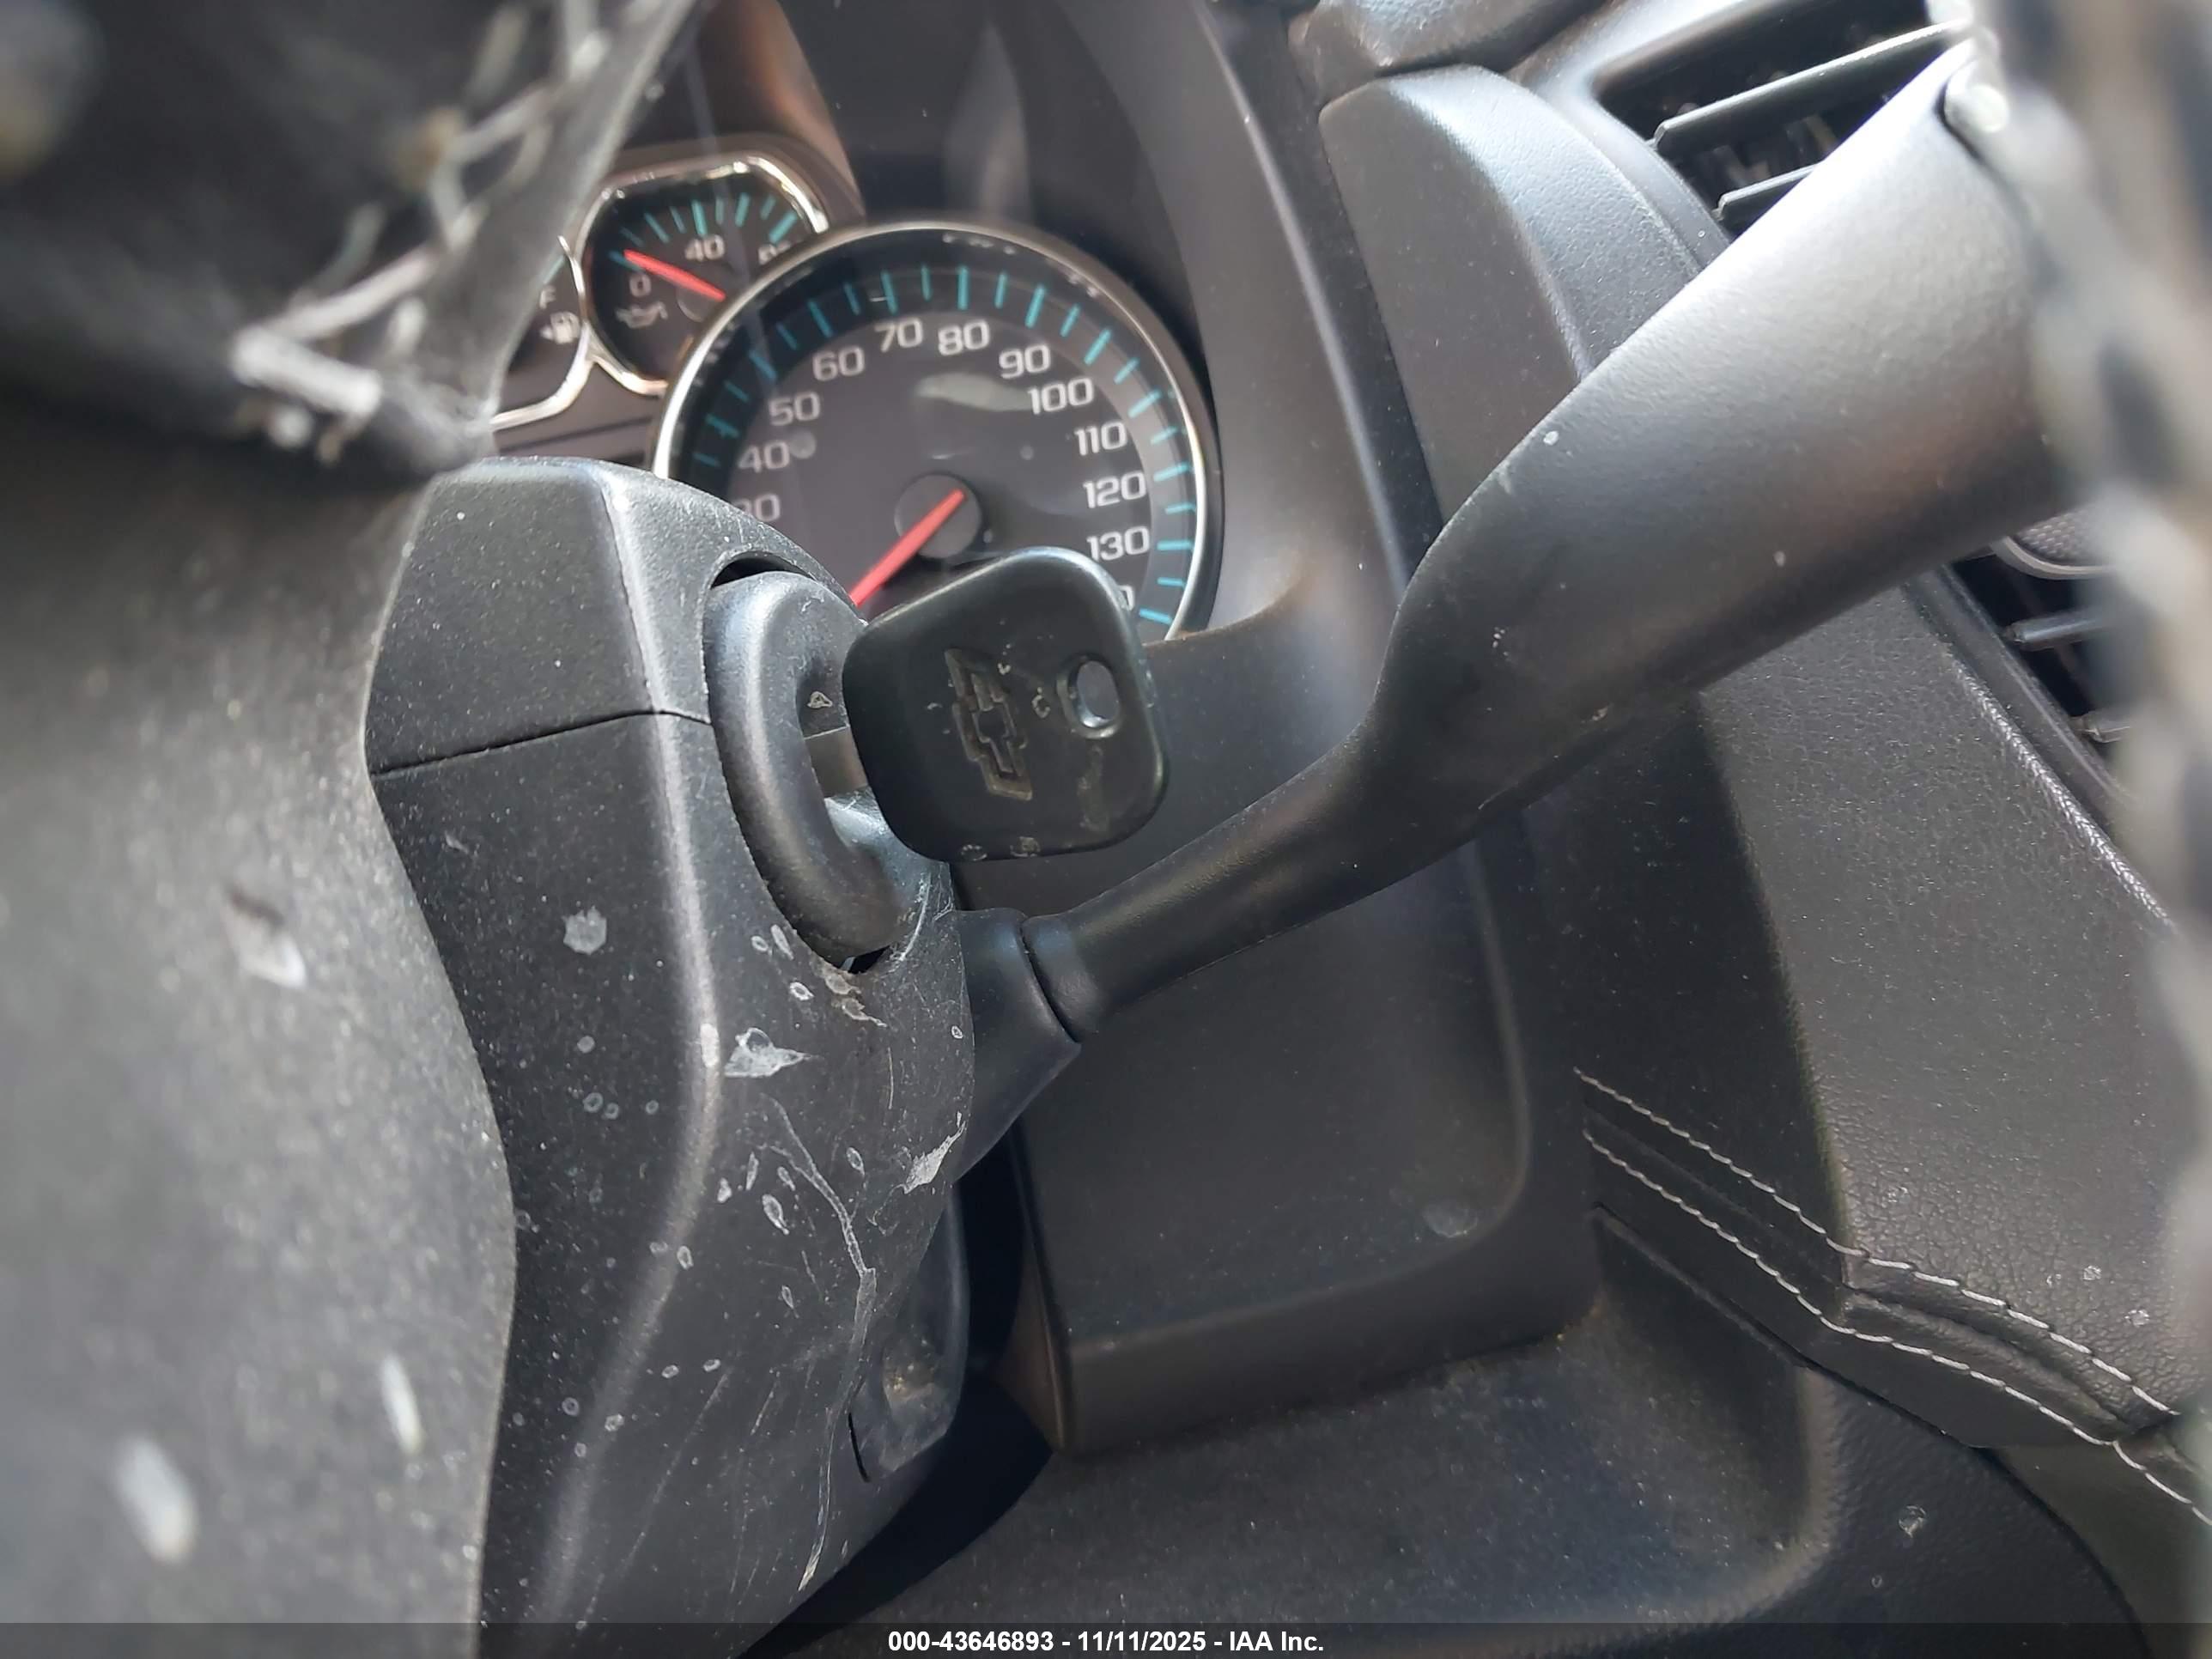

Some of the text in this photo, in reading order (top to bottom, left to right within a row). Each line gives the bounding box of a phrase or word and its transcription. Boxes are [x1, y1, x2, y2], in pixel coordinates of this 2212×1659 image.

[684, 234, 725, 263] 40
[874, 318, 924, 354] 70
[937, 321, 990, 357] 80
[813, 347, 866, 382] 60
[999, 343, 1051, 380] 90
[769, 391, 823, 426] 50
[1027, 377, 1094, 415] 100
[1073, 421, 1128, 457] 110
[737, 441, 790, 474] 40
[1082, 471, 1146, 508] 120
[1086, 526, 1150, 562] 130
